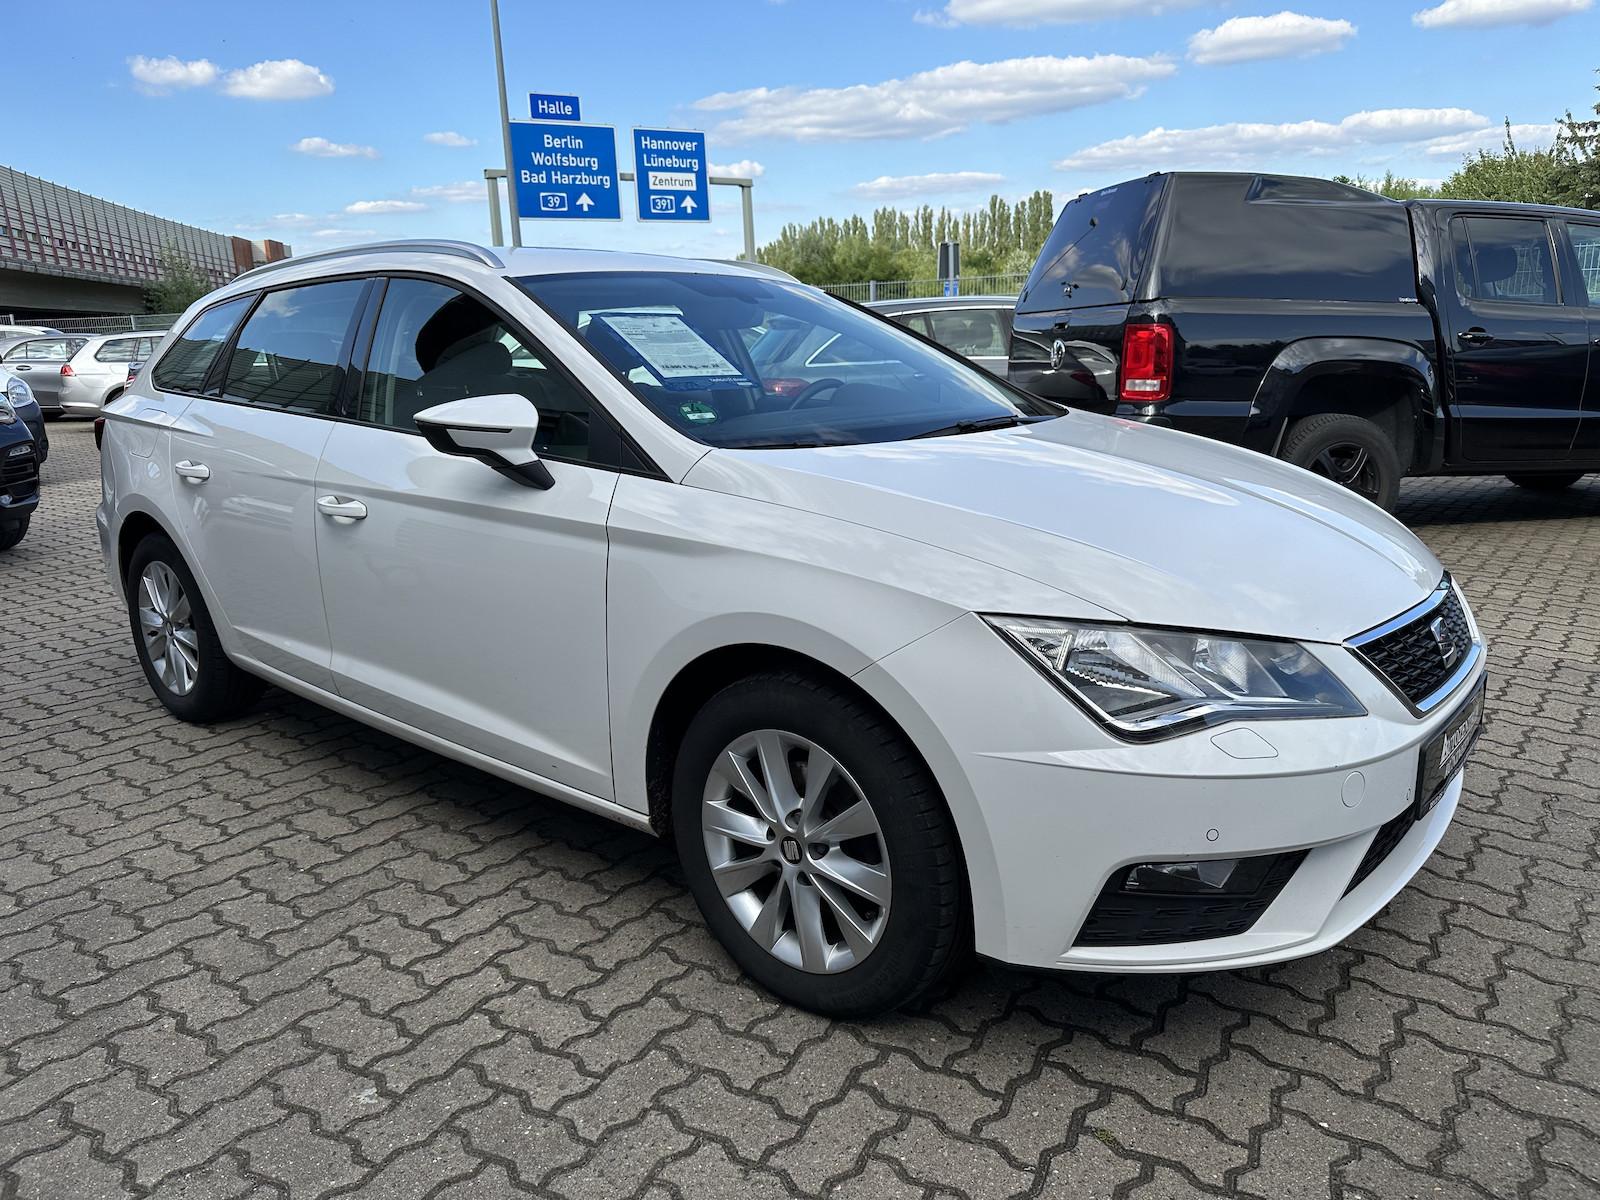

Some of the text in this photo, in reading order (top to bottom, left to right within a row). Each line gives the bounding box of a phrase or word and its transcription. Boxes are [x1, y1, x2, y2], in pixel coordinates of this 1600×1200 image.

[538, 100, 573, 115] Halle
[543, 134, 583, 149] Berlin
[641, 136, 698, 151] Hannover
[531, 152, 599, 171] Wolfsburg
[643, 153, 699, 171] Lüneburg
[521, 169, 611, 188] Bad Harzburg
[652, 176, 694, 187] Zentrum
[547, 196, 561, 207] 39
[655, 199, 671, 210] 391
